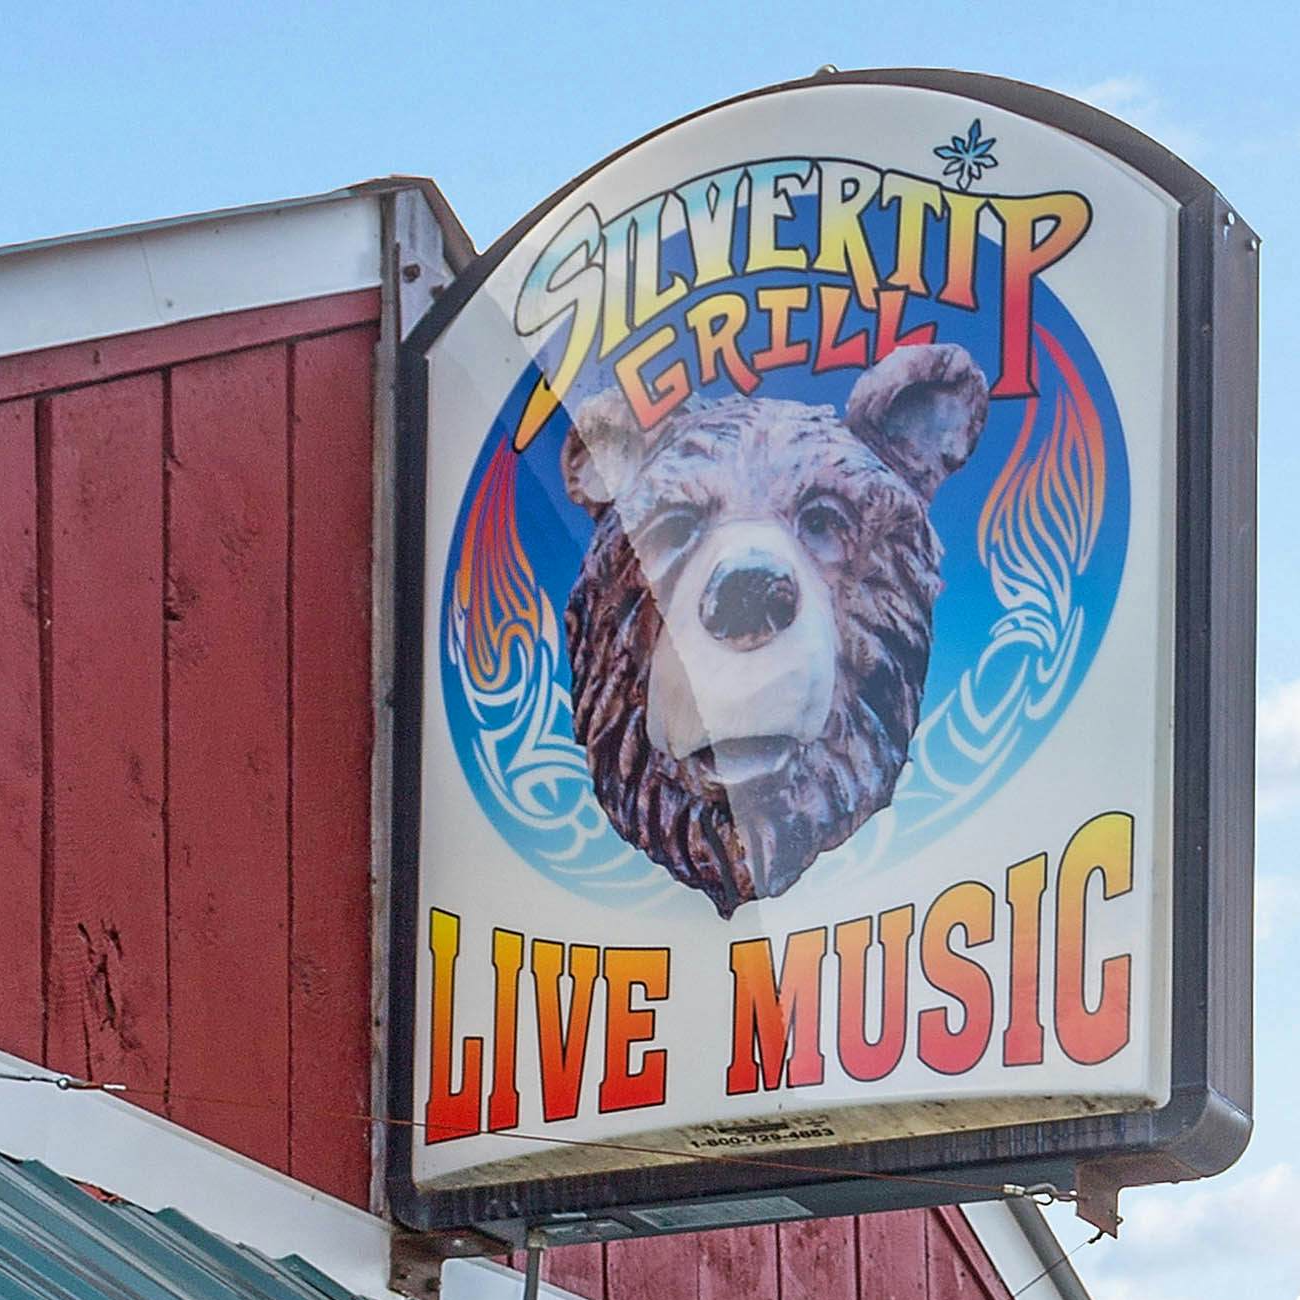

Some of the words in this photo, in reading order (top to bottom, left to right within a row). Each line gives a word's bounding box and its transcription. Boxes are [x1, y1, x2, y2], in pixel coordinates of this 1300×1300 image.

[514, 156, 1093, 454] SILVERTIP
[615, 285, 938, 431] GRILL
[424, 906, 672, 1146] LIVE
[725, 810, 1136, 1097] MUSIC
